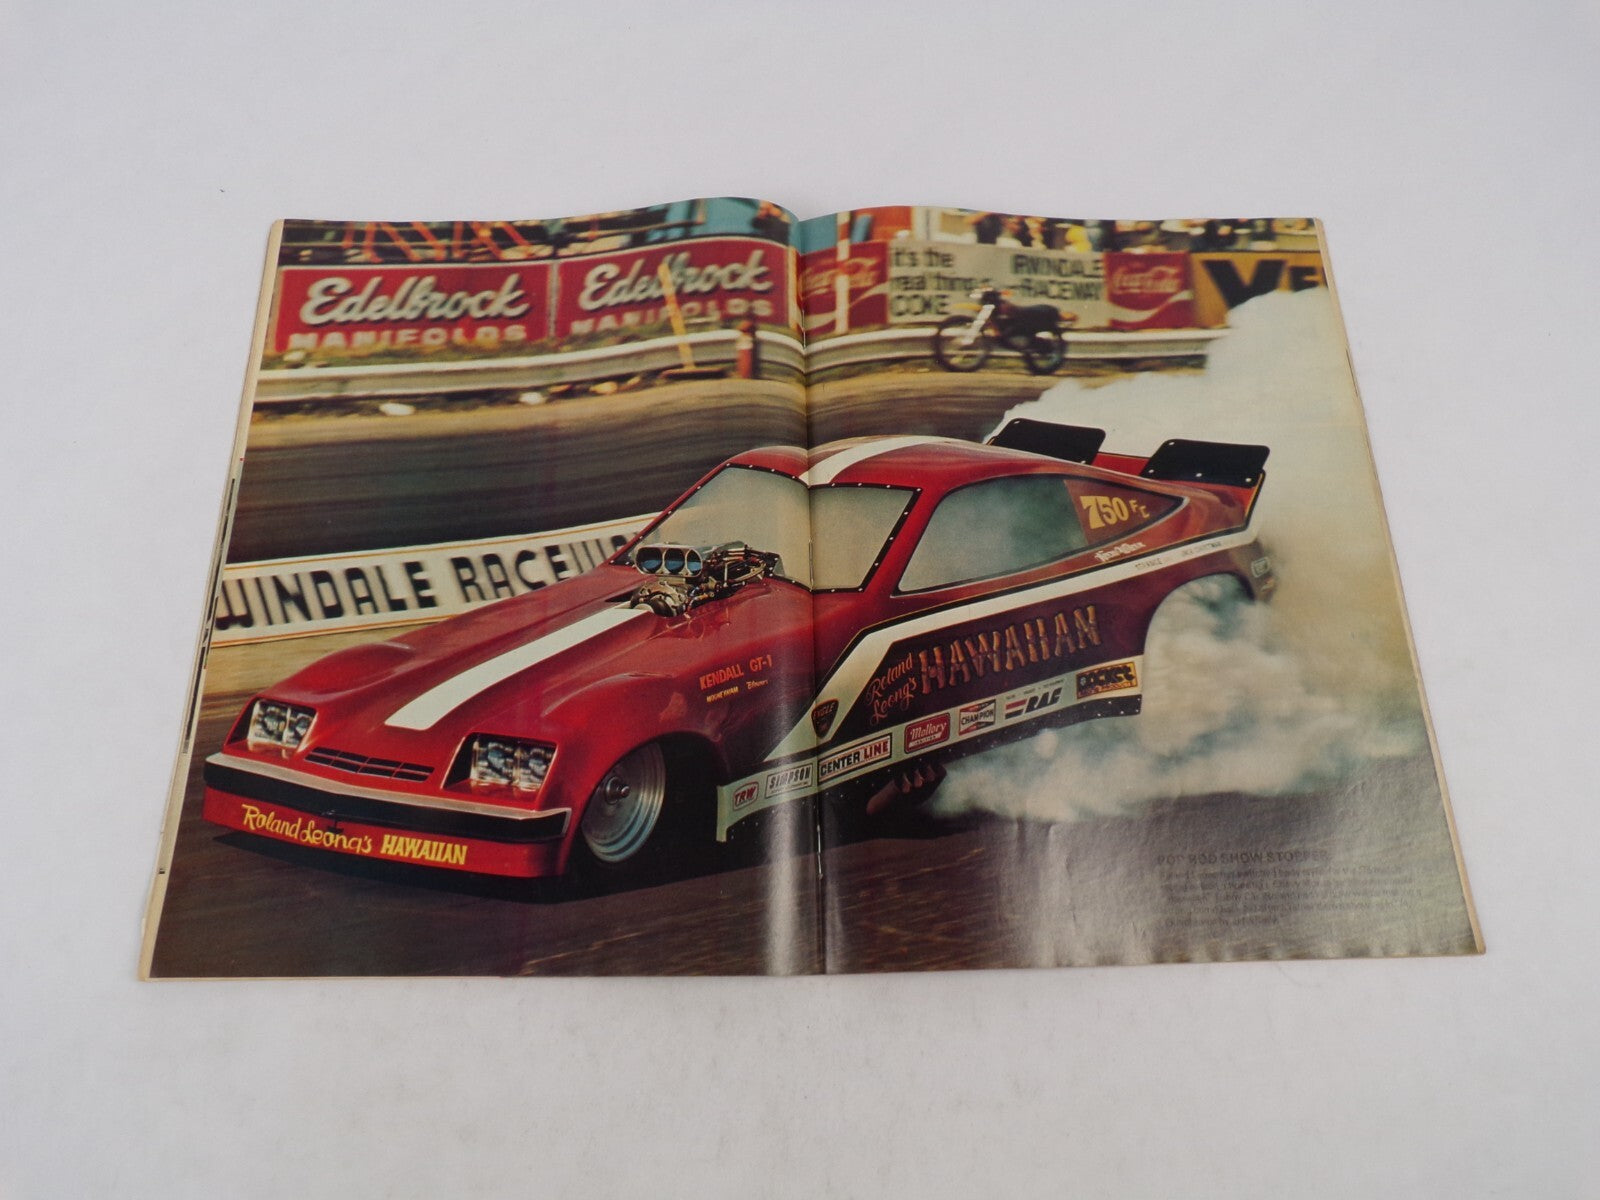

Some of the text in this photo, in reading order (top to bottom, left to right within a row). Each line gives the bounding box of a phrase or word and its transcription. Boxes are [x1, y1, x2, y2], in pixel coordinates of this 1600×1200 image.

[300, 273, 530, 326] Edelbrock
[1079, 495, 1130, 530] 750
[918, 605, 1103, 695] HAWAIIAN
[699, 654, 773, 691] KENDALL GT-1
[909, 721, 948, 741] Mallory
[961, 710, 994, 725] CHAMPION
[820, 752, 860, 777] CENTER
[862, 738, 890, 759] LINE
[734, 785, 757, 804] TRW
[768, 765, 812, 789] SIMPSON
[242, 803, 468, 866] Roland Leong's HAWAIIAN
[1220, 851, 1262, 865] SHOW
